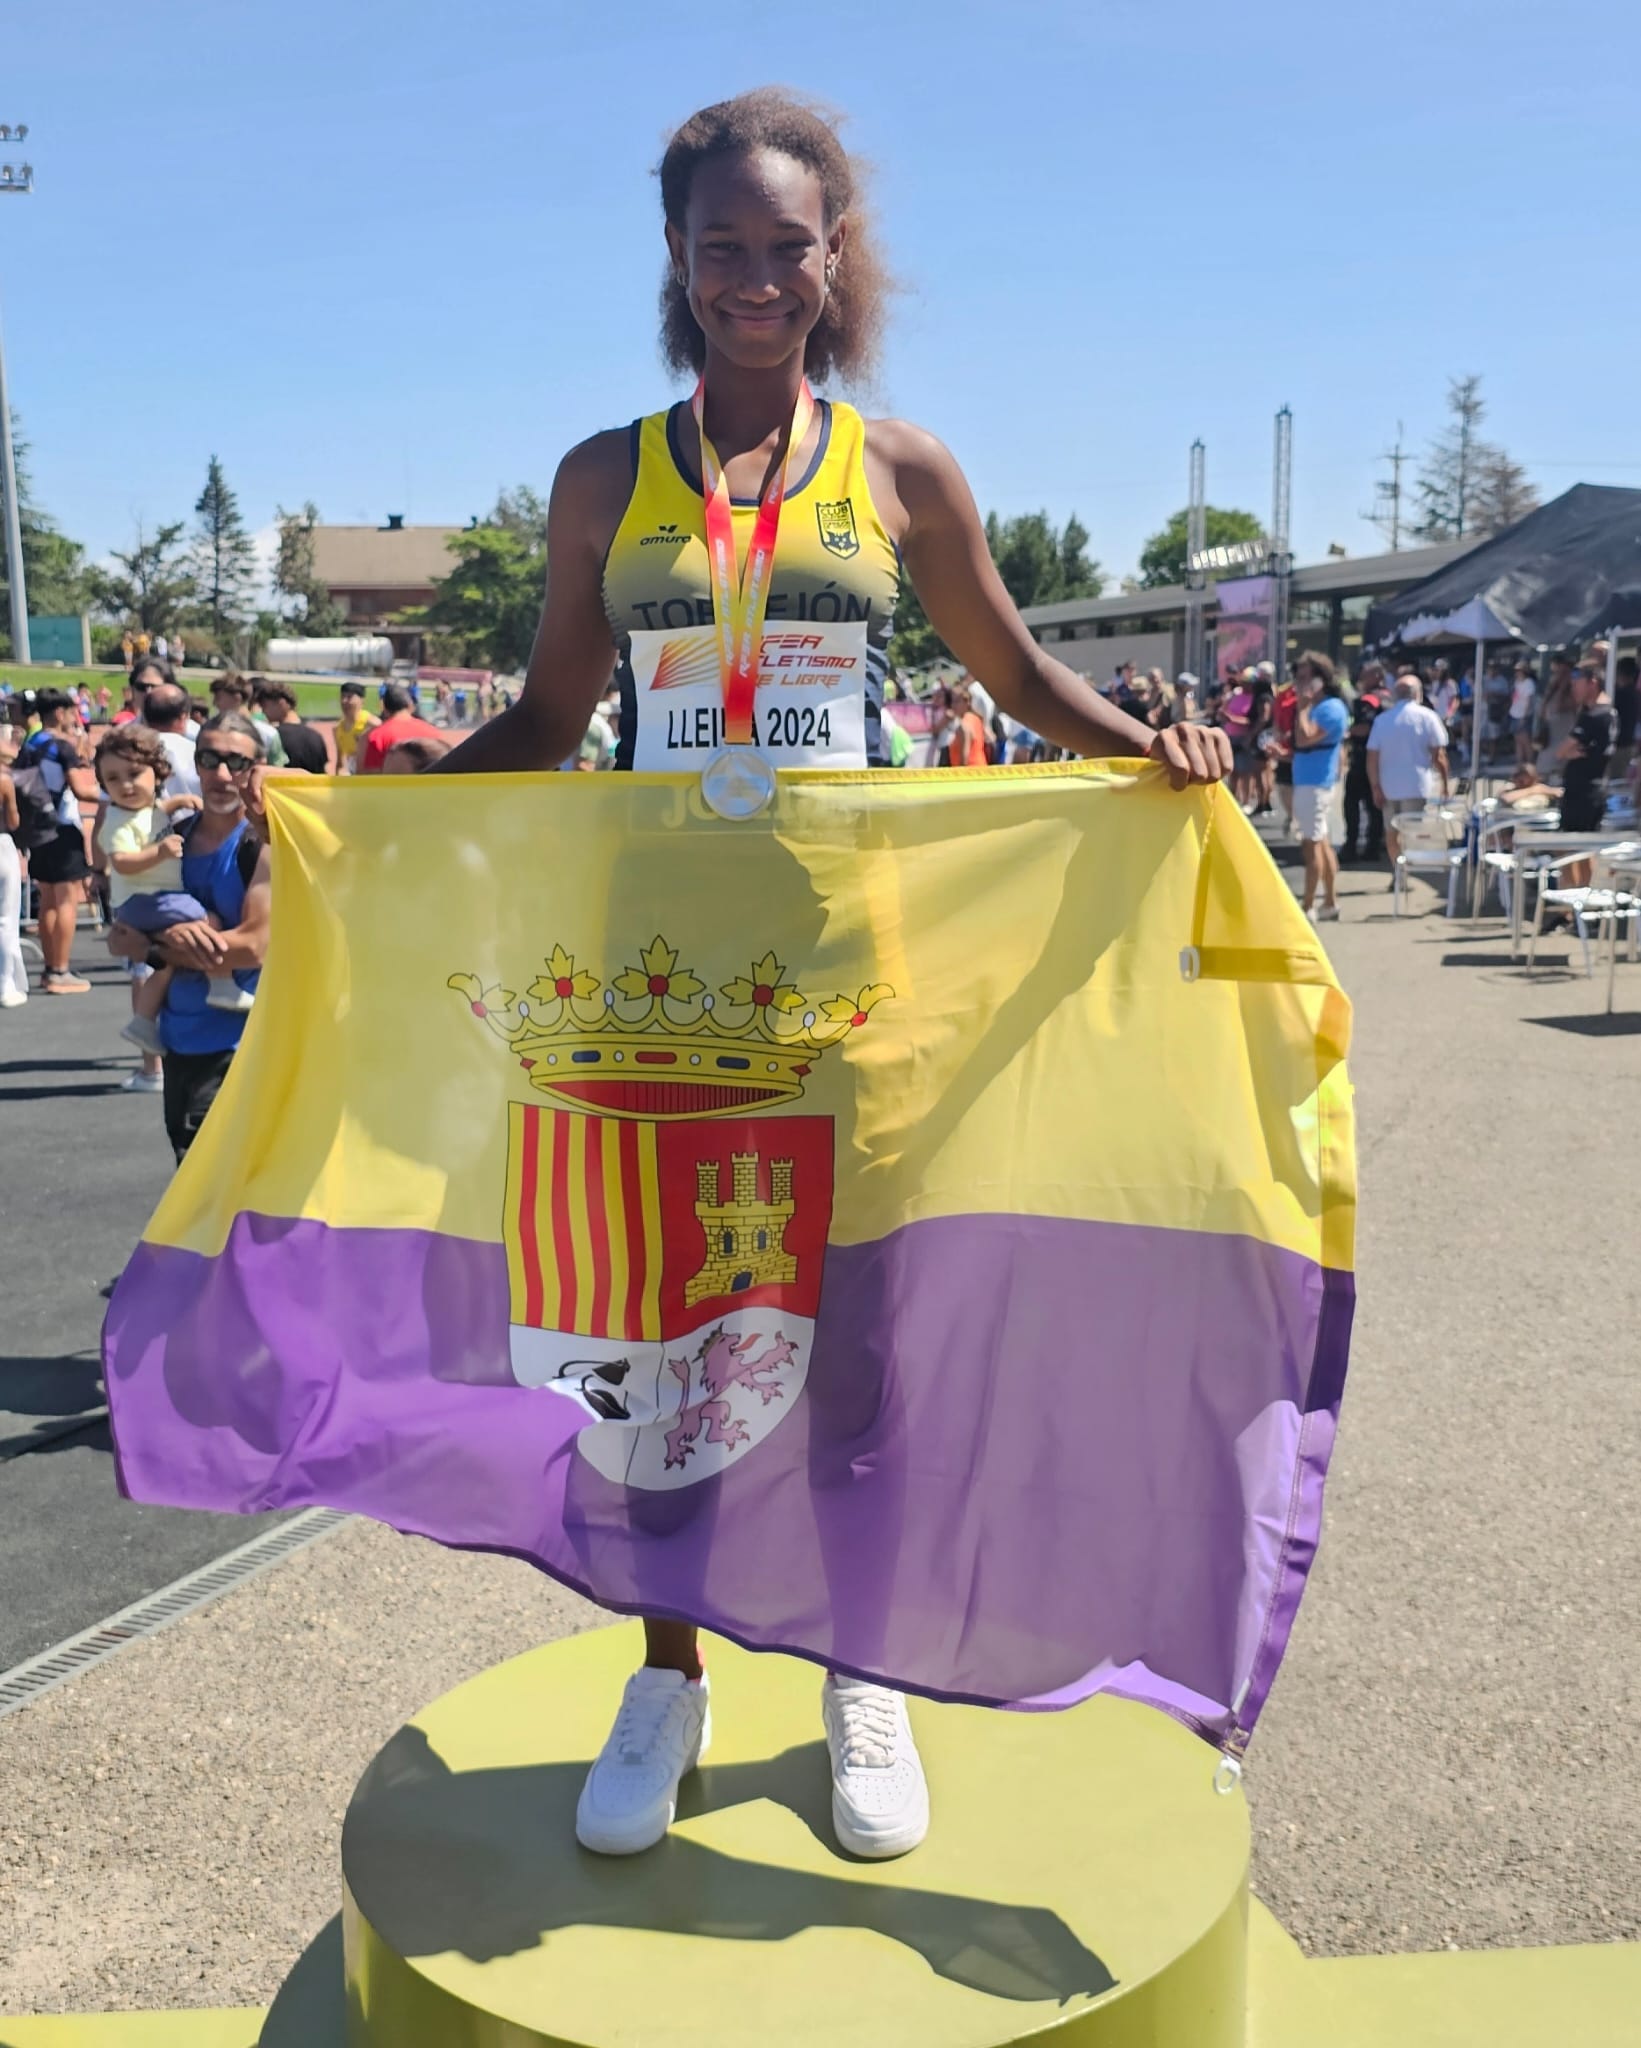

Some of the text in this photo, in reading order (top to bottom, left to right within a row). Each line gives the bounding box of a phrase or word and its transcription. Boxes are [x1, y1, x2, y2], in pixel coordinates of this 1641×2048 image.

[760, 633, 825, 653] FEA
[759, 654, 858, 670] LETISMO
[767, 707, 831, 747] 2024
